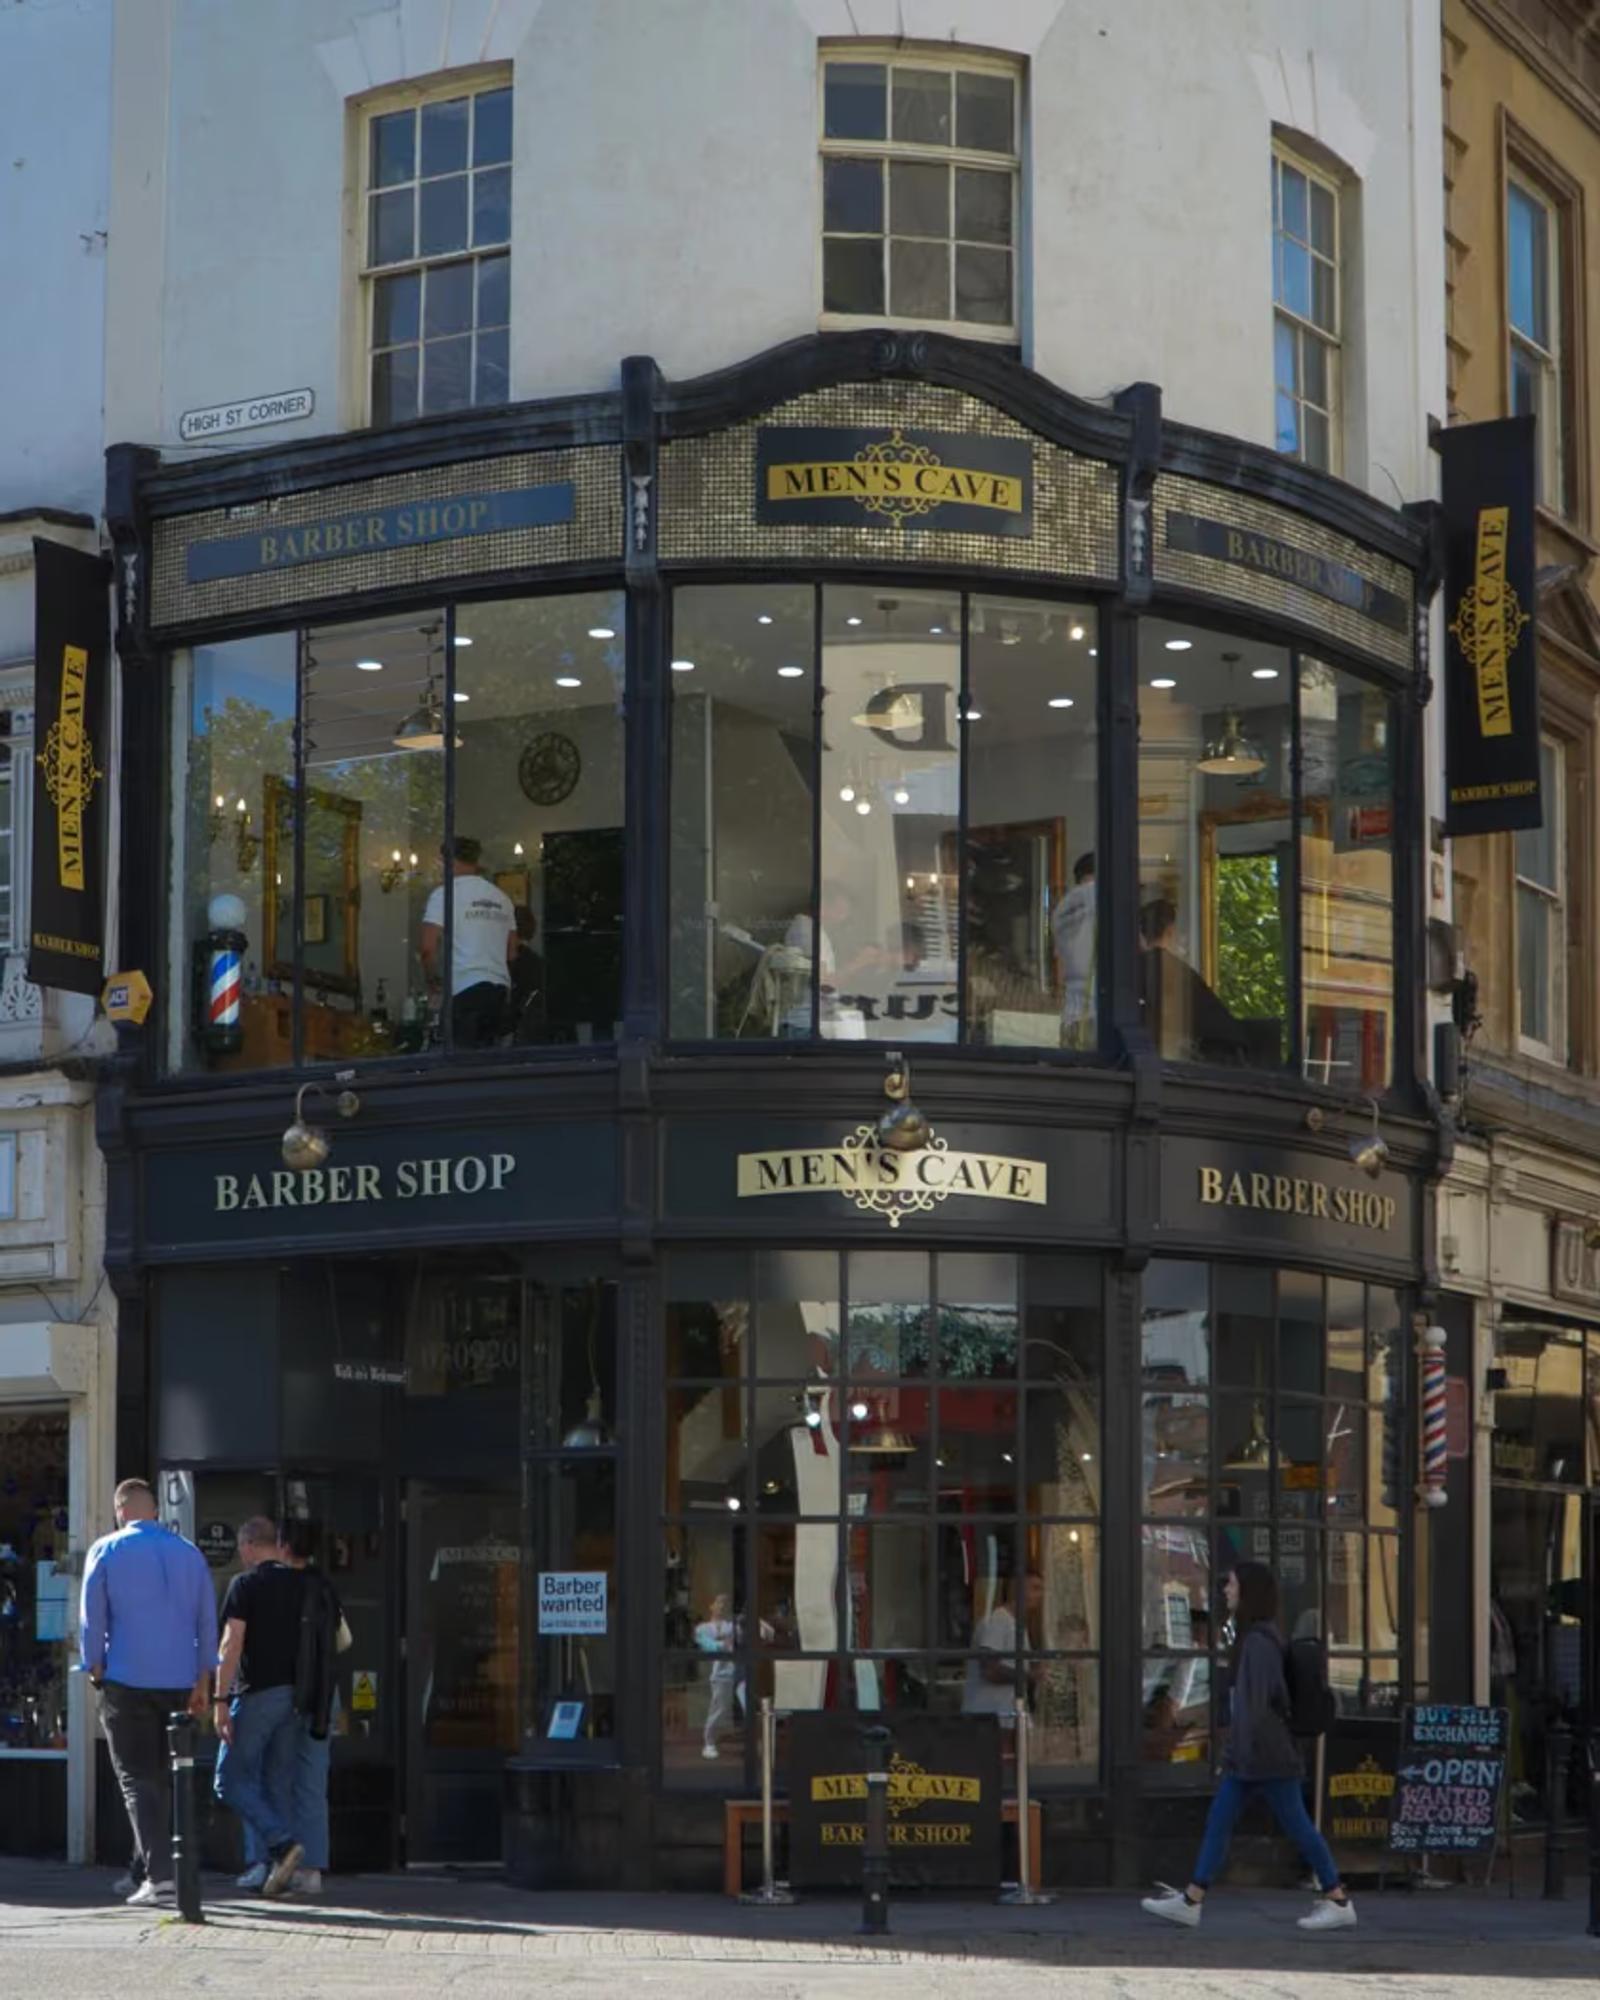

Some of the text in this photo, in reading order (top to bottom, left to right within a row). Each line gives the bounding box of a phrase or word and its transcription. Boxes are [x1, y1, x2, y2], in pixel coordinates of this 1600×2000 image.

[187, 396, 306, 433] HIGH ST CORNER
[783, 464, 1010, 507] MEN'S CAVE
[260, 500, 489, 565] BARBER SHOP
[1227, 531, 1324, 587] BARBER
[1478, 519, 1508, 722] MEN'S CAVE
[63, 656, 85, 750] CAVE
[214, 1153, 517, 1211] BARBER SHOP
[755, 1152, 1034, 1198] MEN'S CAVE
[1199, 1166, 1397, 1231] BARBER SHOP
[541, 1594, 604, 1612] wanted
[544, 1576, 602, 1595] Barber
[1413, 1724, 1500, 1743] EXCHANGE
[907, 1777, 972, 1799] CAVE
[1423, 1758, 1499, 1786] OPEN
[1400, 1803, 1492, 1825] RECORDS
[1401, 1785, 1490, 1807] WANTED
[820, 1824, 971, 1843] BARR SHOP
